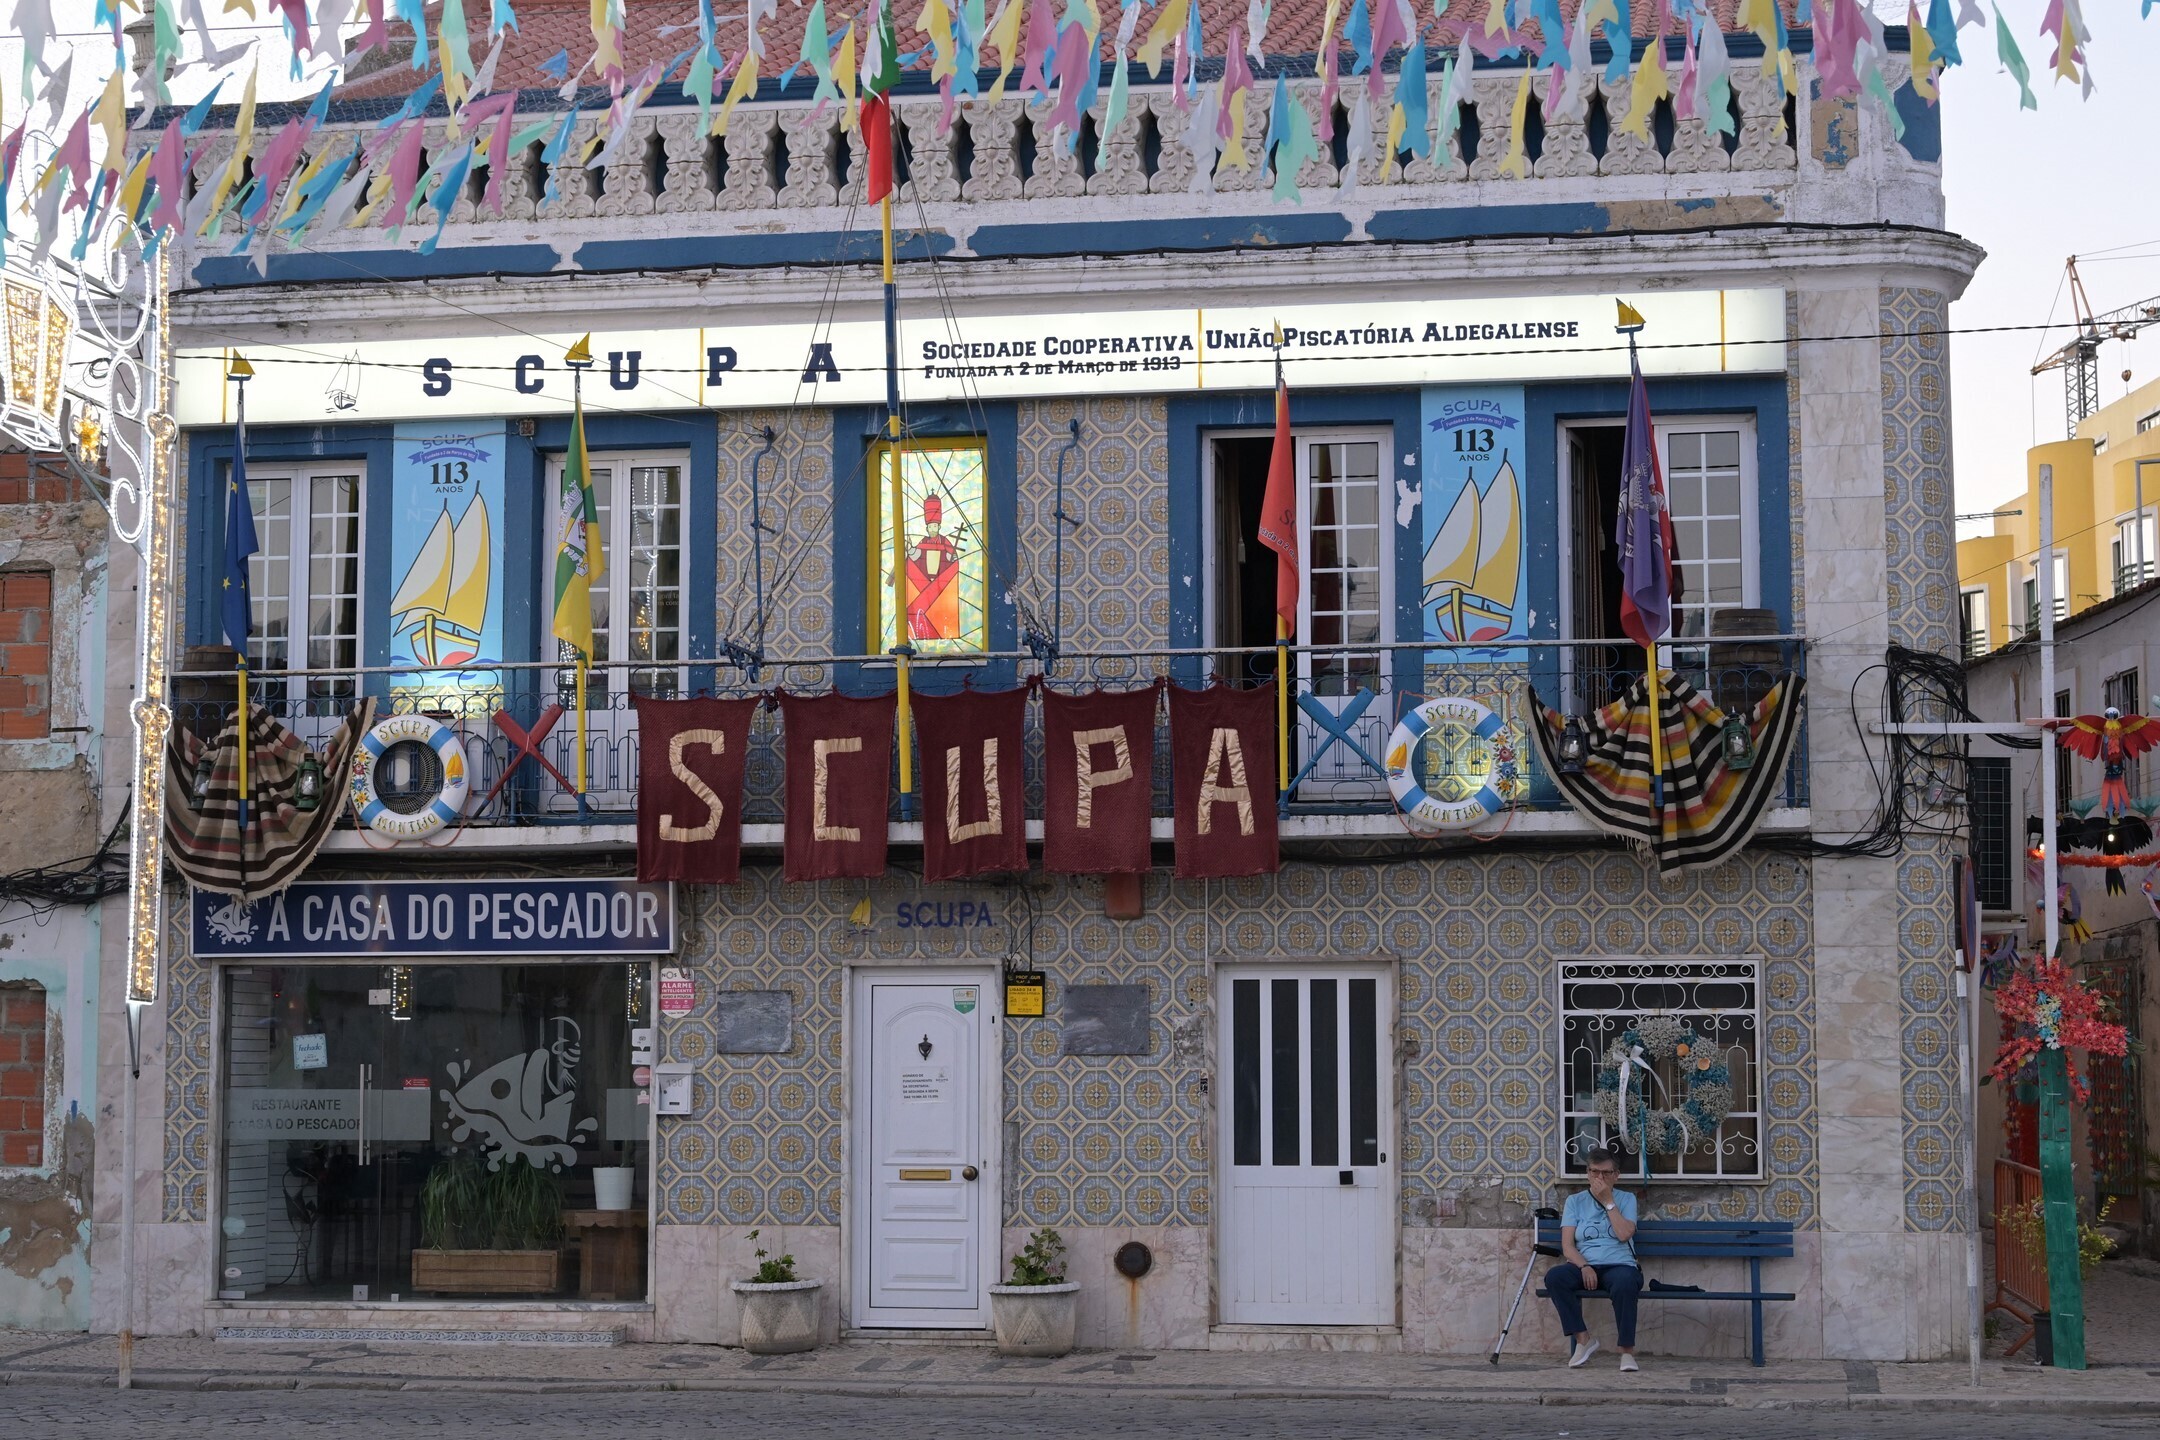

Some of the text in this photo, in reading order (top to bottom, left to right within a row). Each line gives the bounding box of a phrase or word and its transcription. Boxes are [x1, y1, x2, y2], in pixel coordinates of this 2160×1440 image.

[923, 341, 1036, 360] SOCIEDADE
[1043, 335, 1193, 355] COOPERATIVA
[1283, 323, 1414, 347] PISCATÓRIA
[1422, 322, 1579, 343] ALDEGALENSE
[925, 356, 1181, 379] FUNDADA A 2 DE MARÇO DE 1913
[1442, 399, 1501, 416] SCUPA
[422, 433, 476, 449] SCUPA
[1453, 429, 1494, 452] 113
[430, 461, 469, 485] 113
[435, 485, 464, 493] ANOS
[1425, 703, 1478, 723] SCUPA
[378, 719, 432, 741] SCUPA
[1418, 801, 1483, 823] MONTIJO
[376, 812, 439, 835] MONTIJO
[266, 891, 660, 942] A CASA DO PESCADOR
[897, 901, 998, 928] S.C.U.P.A.
[666, 1078, 683, 1088] 130
[252, 1099, 342, 1111] RESTAURANTE
[276, 1118, 293, 1130] DO
